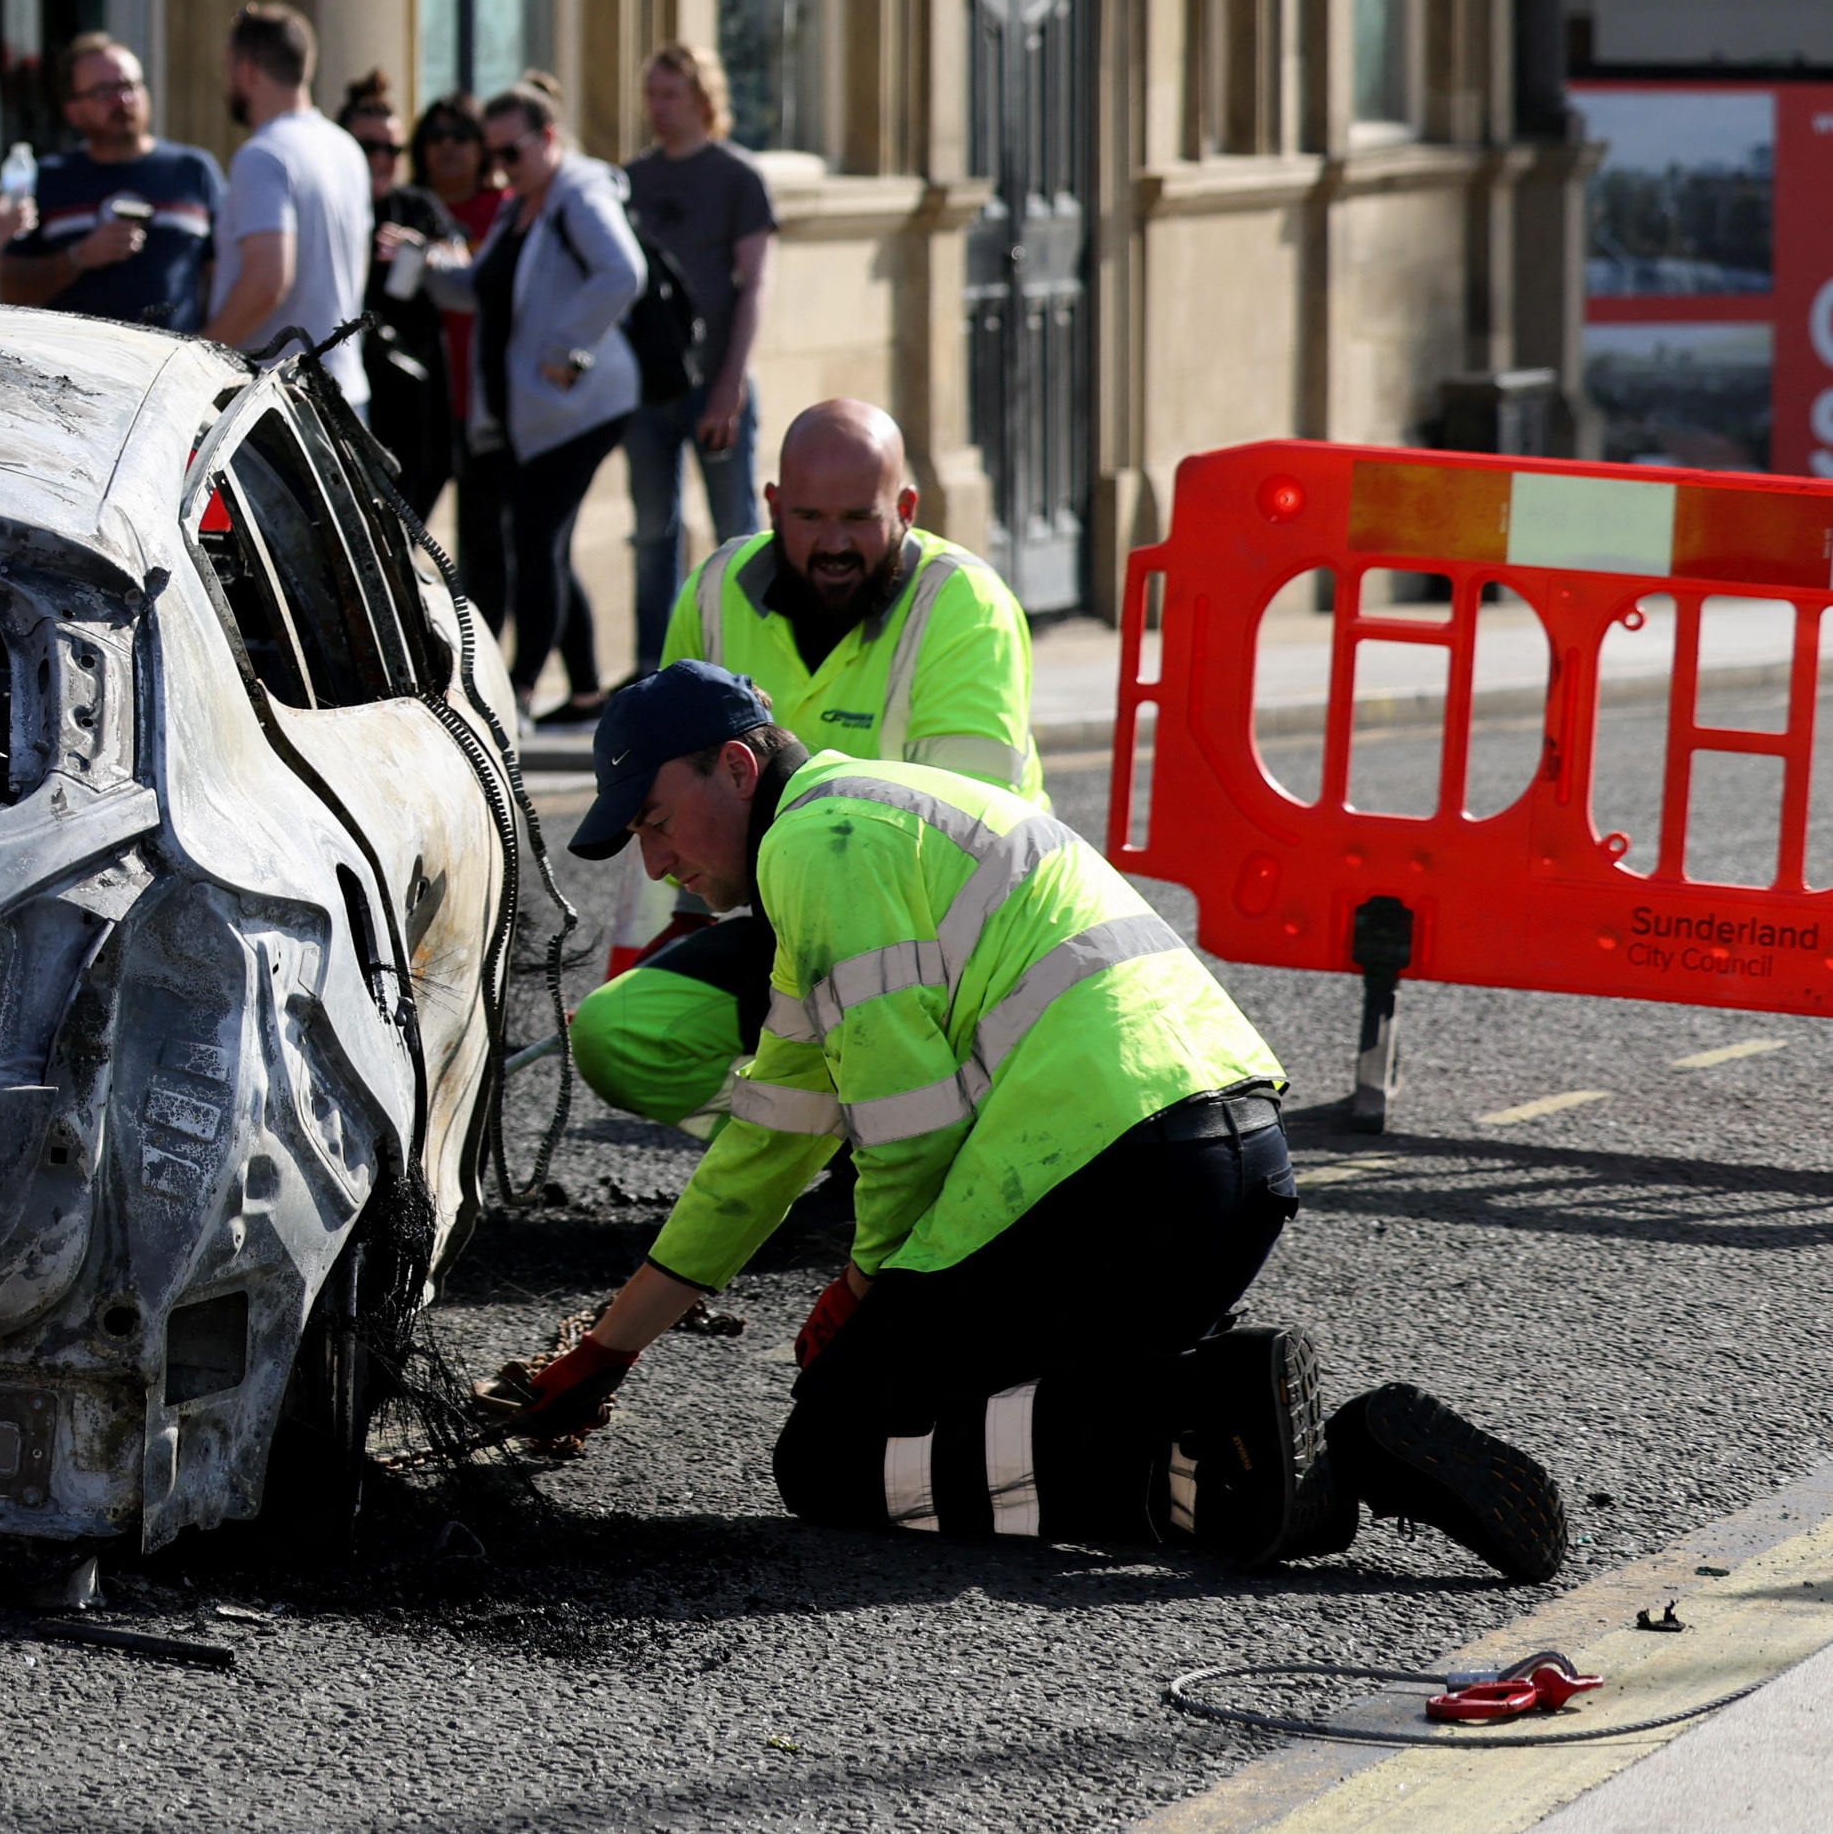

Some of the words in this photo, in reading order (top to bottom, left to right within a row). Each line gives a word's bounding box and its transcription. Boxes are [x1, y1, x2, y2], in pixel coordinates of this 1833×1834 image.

[1631, 906, 1819, 950] Sunderland
[1627, 943, 1675, 973] City
[1681, 947, 1774, 978] Council
